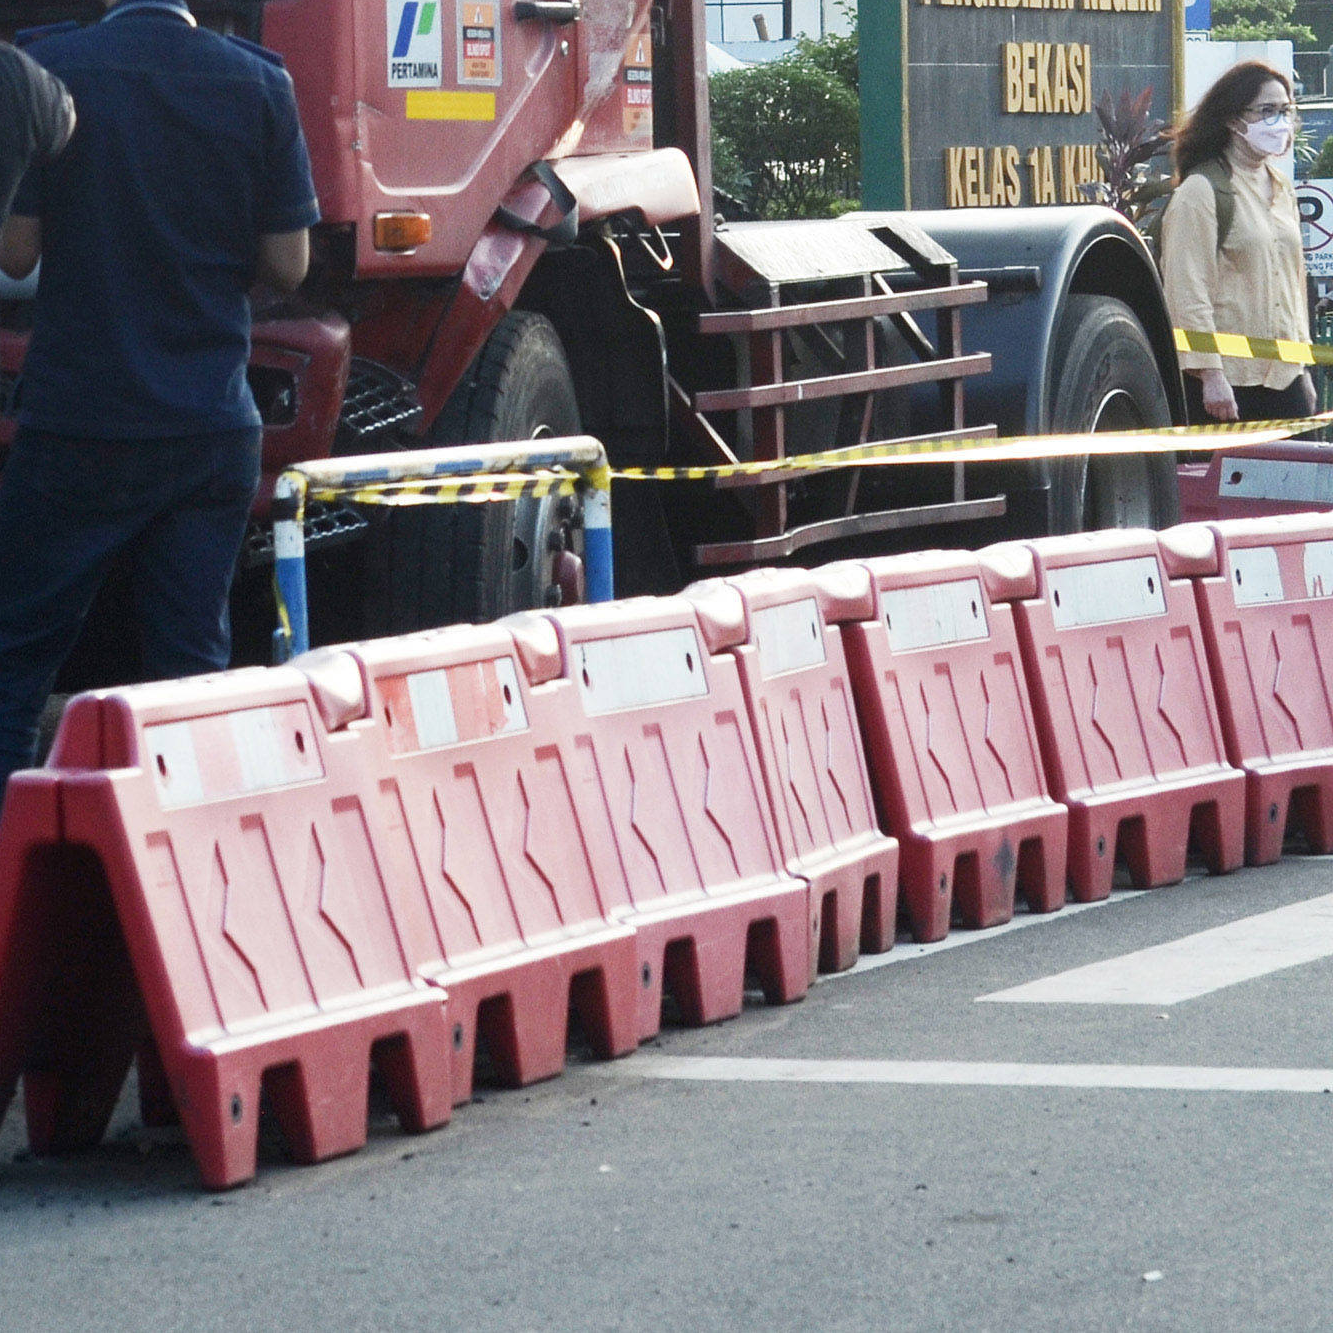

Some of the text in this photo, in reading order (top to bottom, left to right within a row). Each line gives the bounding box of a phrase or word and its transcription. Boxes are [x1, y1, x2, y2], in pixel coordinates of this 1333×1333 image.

[391, 63, 439, 80] PERTAMINA
[1002, 42, 1092, 114] BEKASI
[945, 145, 1021, 208] KELAS
[1028, 145, 1056, 205] 1A
